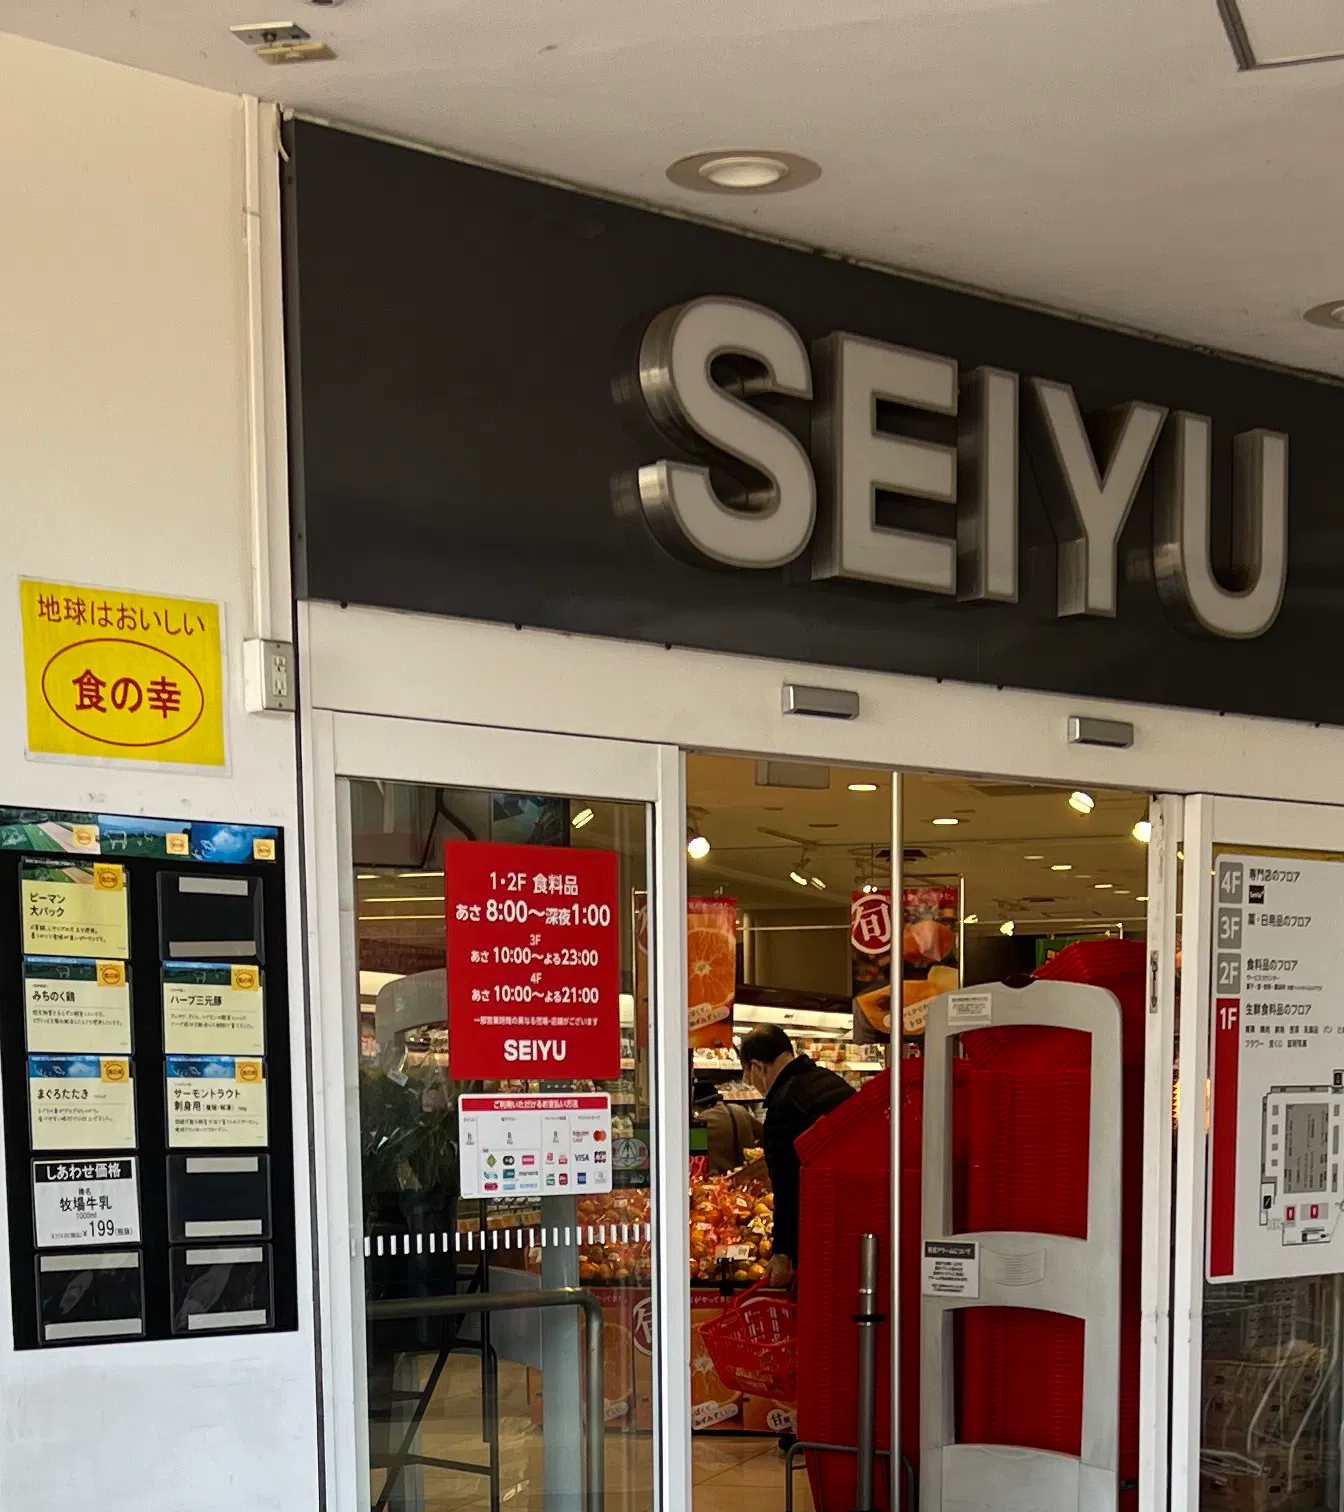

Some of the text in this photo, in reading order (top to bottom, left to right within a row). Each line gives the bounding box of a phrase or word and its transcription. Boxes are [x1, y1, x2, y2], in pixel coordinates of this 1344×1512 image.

[638, 294, 1289, 640] SEIYU
[37, 593, 205, 636] 地球はおいしい
[72, 668, 182, 719] 食の幸
[532, 873, 579, 896] 食料品
[1221, 871, 1242, 894] 4F
[30, 905, 65, 918] 大パック
[455, 903, 482, 922] あさ
[858, 901, 891, 942] 旬
[1220, 916, 1241, 940] 3F
[529, 933, 542, 946] 3F
[470, 950, 490, 964] あさ
[1246, 958, 1298, 972] 食料品のフロア
[529, 971, 542, 984] 4F
[1219, 961, 1239, 984] 2F
[471, 988, 490, 1002] あさ
[1219, 1007, 1238, 1030] 1F
[503, 1039, 567, 1062] SEIYU
[37, 1088, 89, 1100] まぐろたたき
[174, 1088, 241, 1100] サーモントラウト
[574, 1153, 590, 1162] VISA
[46, 1161, 122, 1181] しあわせ価格
[59, 1195, 113, 1212] 牧場牛乳
